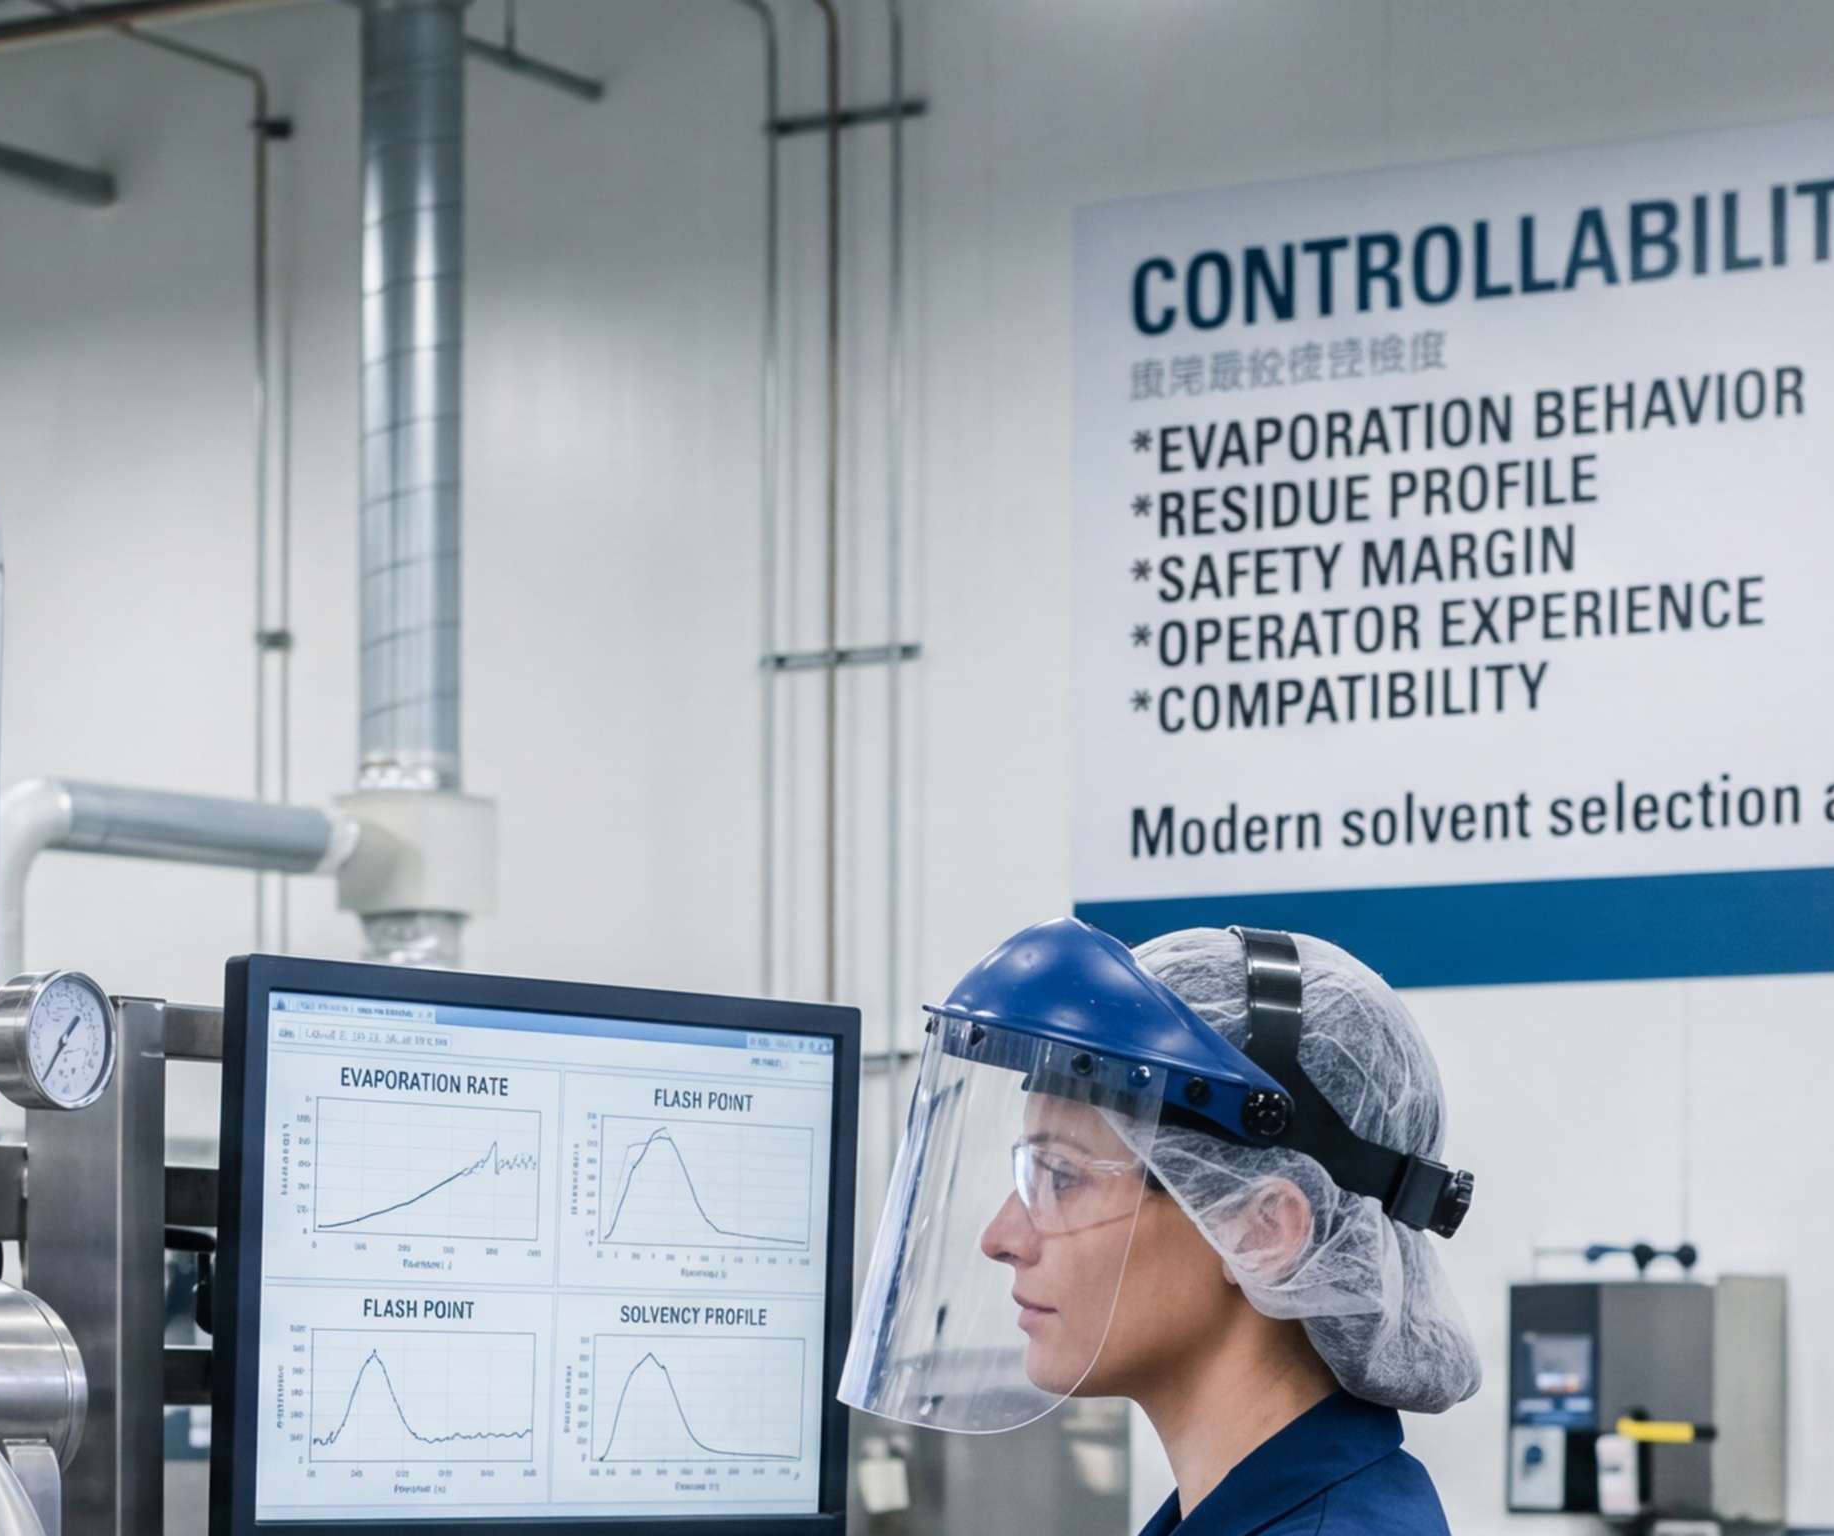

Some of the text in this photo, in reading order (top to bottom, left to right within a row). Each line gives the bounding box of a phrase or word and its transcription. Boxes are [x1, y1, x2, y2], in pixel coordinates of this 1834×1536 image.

[1535, 366, 1806, 441] BEHAVIOR
[1390, 454, 1598, 519] PROFILE
[1364, 524, 1576, 588] MARGIN
[1442, 576, 1765, 648] EXPERIENCE
[1131, 806, 1321, 858] Modern
[1342, 792, 1531, 848] solvent
[1550, 775, 1801, 836] selection
[341, 1066, 509, 1096] EVAPORATION RATE
[654, 1088, 754, 1112] FLASH POINT
[363, 1298, 475, 1319] FLASH POINT
[620, 1305, 767, 1326] SOLVENCY PROFILE
